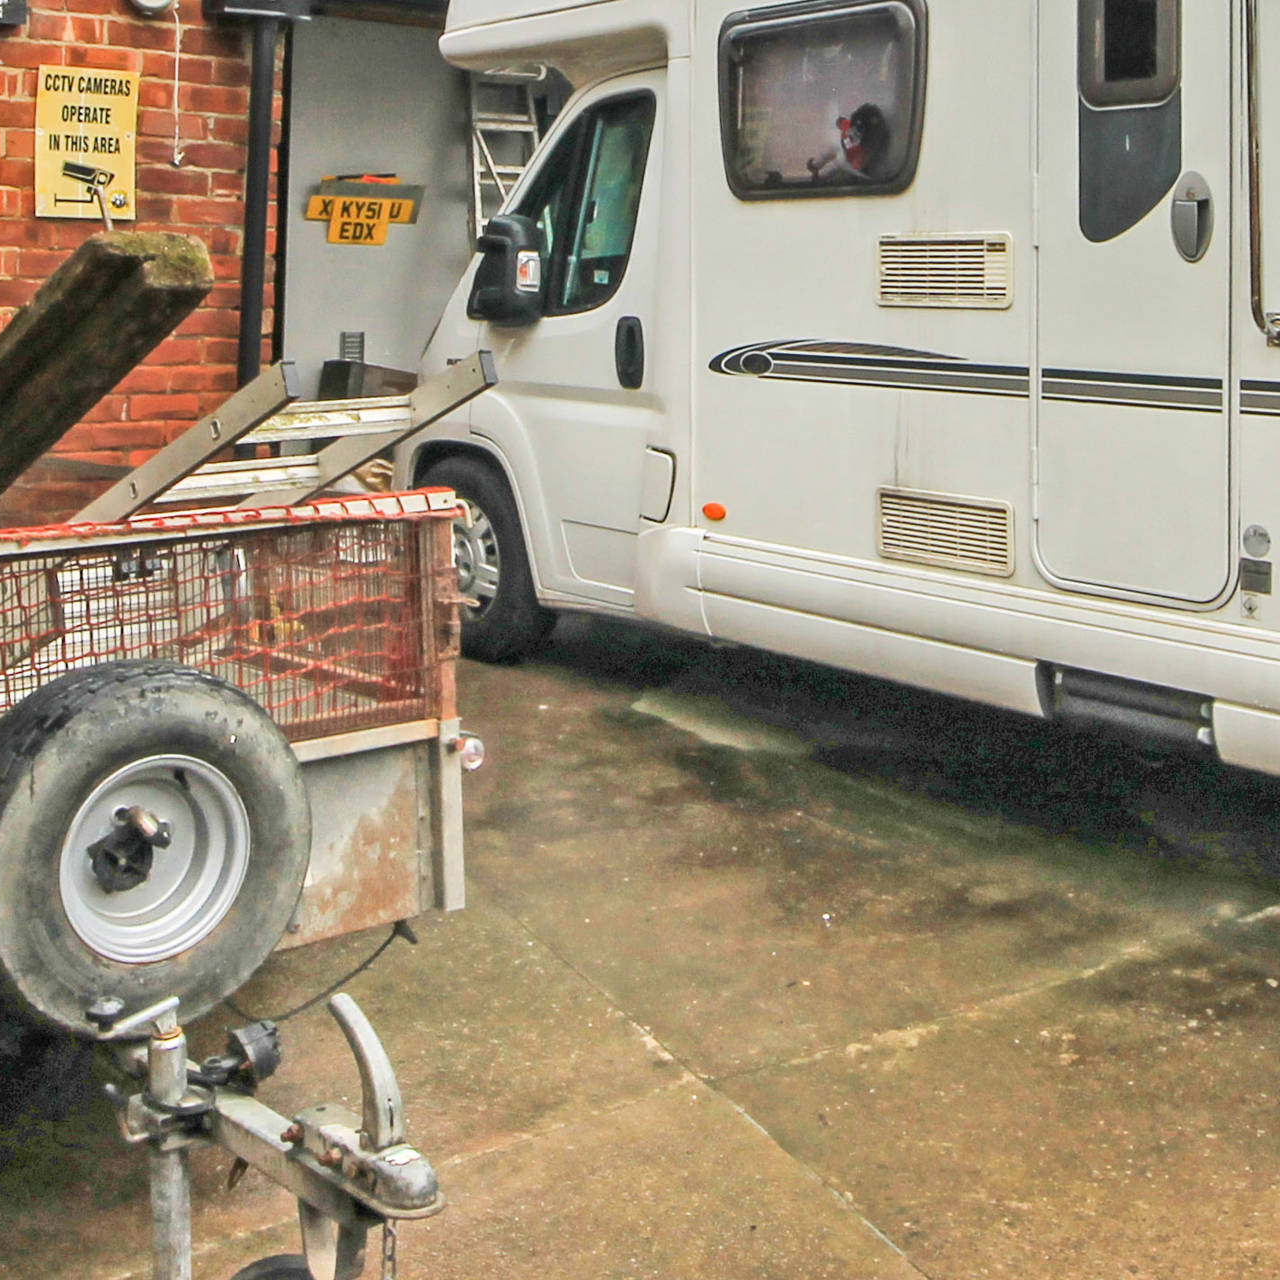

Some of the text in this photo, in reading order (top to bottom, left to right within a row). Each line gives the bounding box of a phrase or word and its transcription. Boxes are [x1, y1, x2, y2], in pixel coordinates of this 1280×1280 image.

[45, 74, 131, 97] CCTV CAMERAS
[61, 105, 112, 124] OPERATE
[49, 134, 120, 154] IN THIS AREA
[338, 222, 376, 240] EDX
